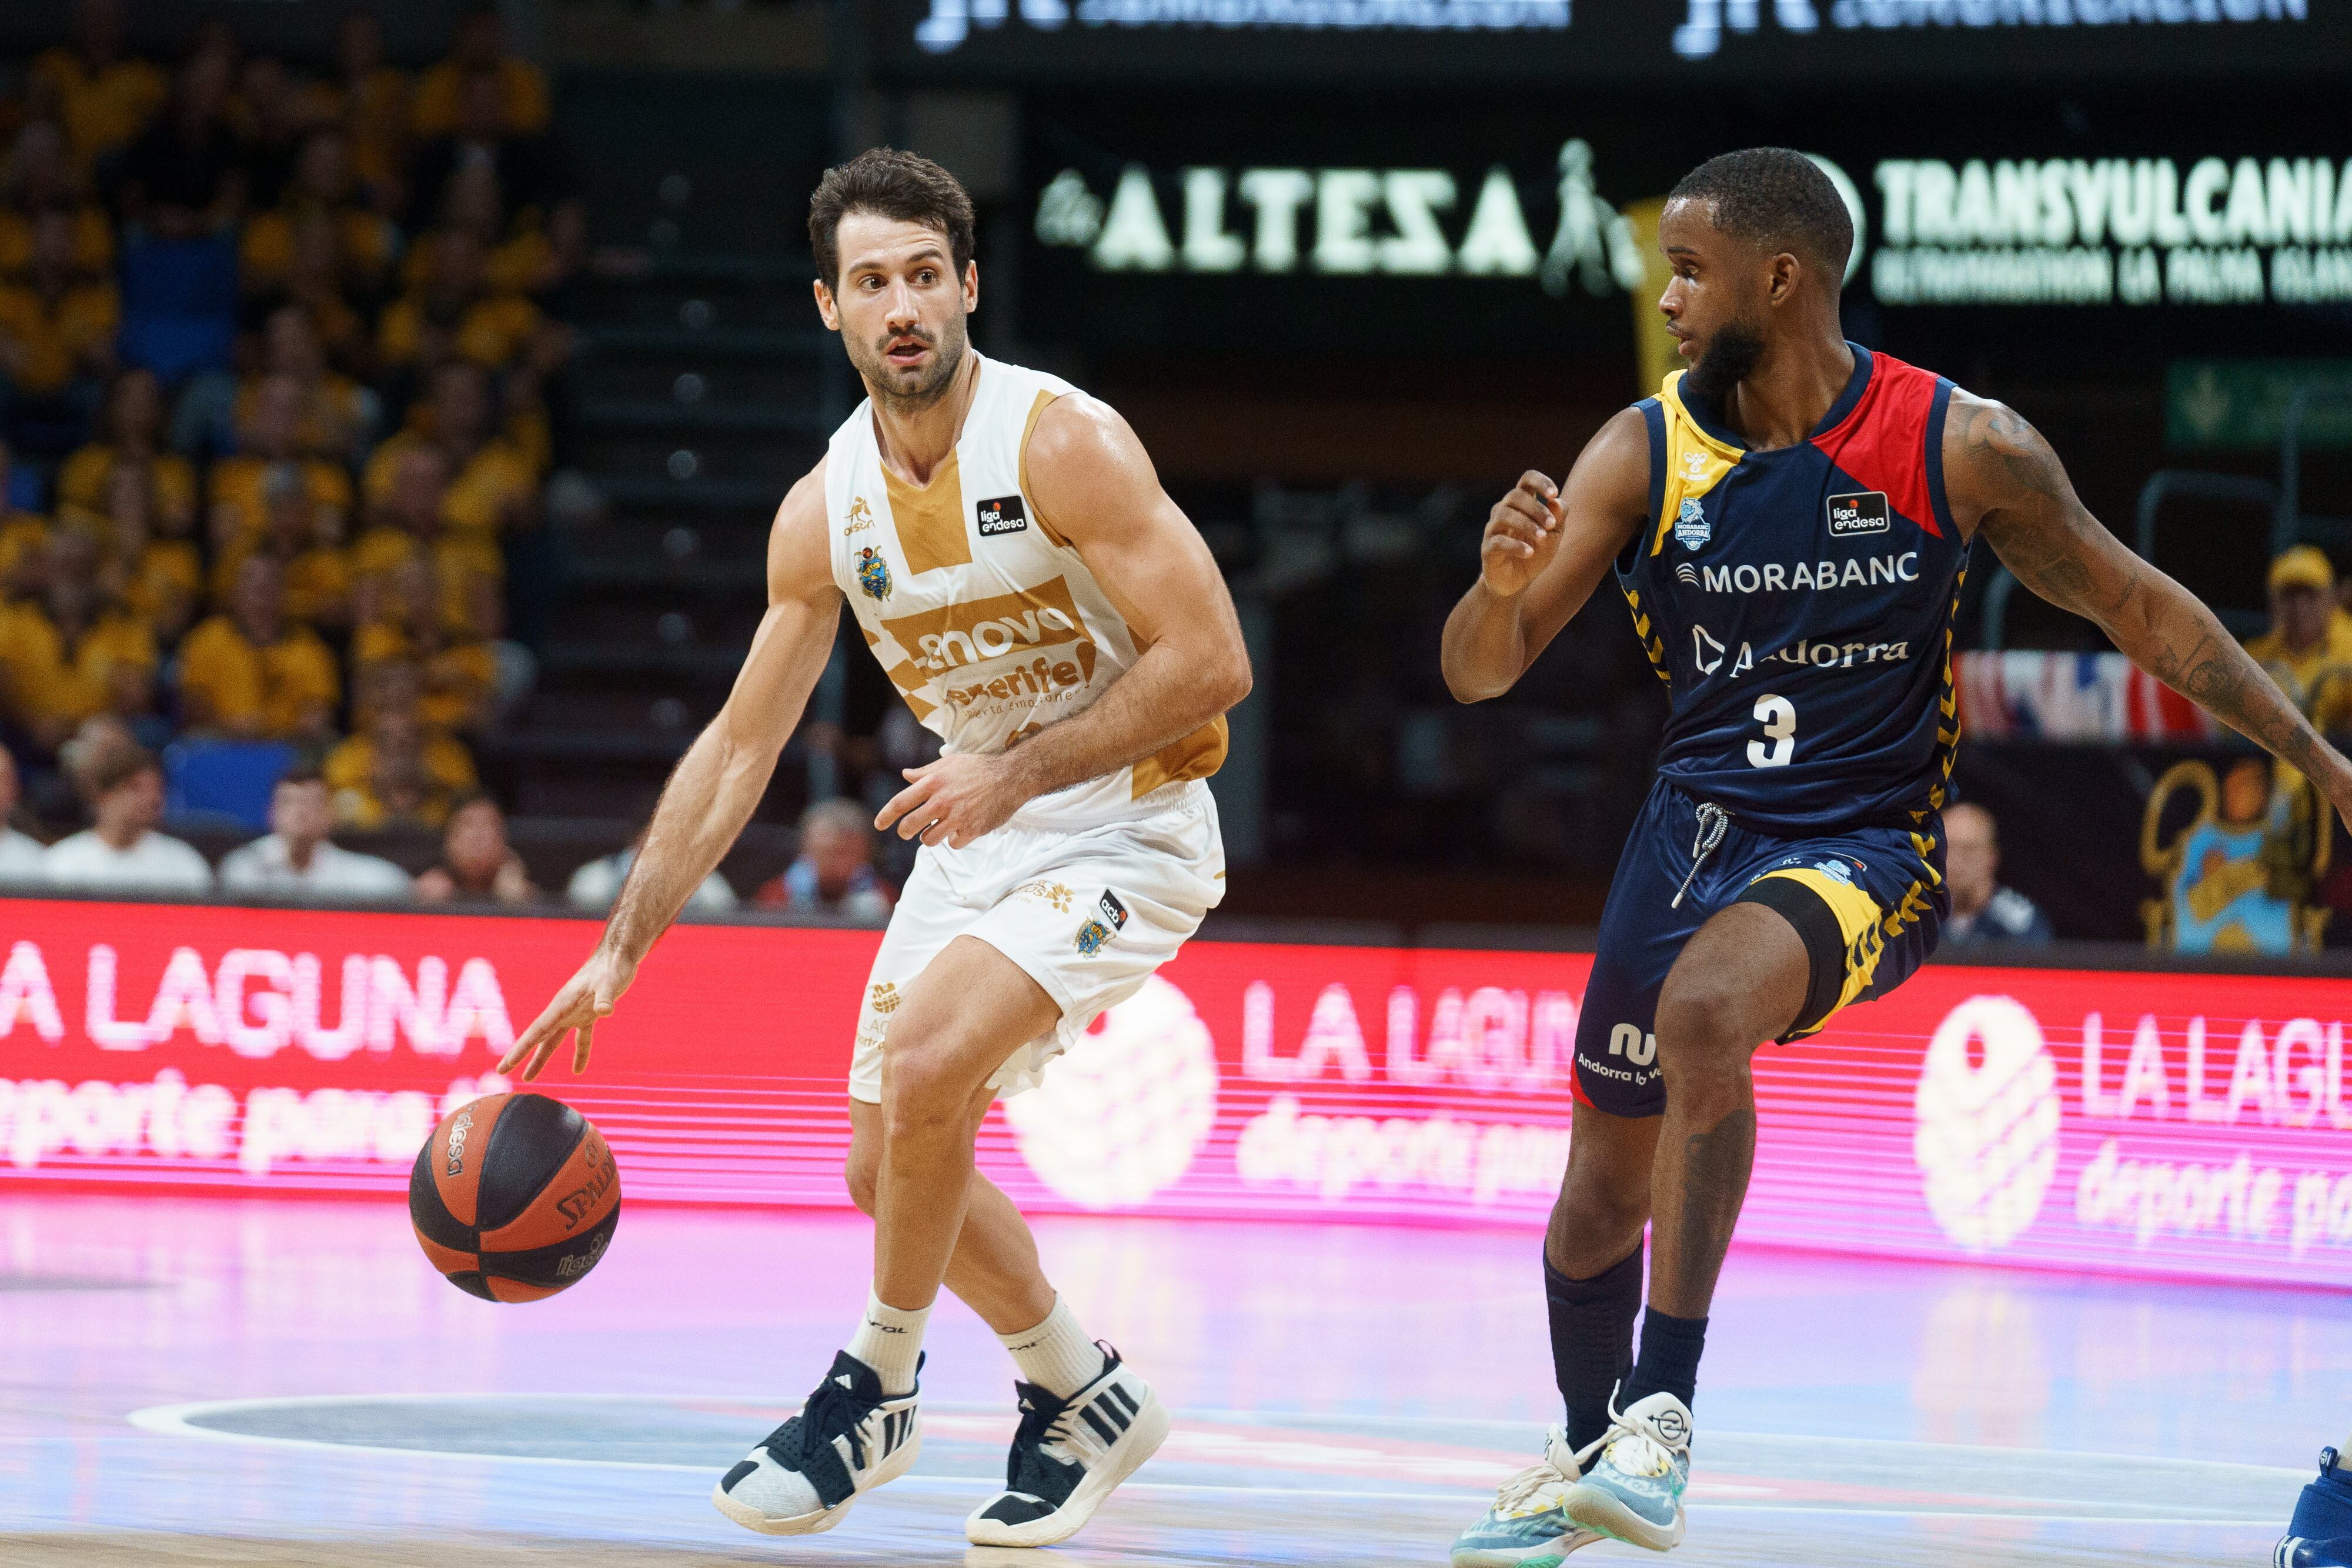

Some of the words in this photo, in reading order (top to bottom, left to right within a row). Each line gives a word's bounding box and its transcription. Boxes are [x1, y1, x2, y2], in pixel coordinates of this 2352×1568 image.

[981, 510, 1000, 522] liga
[982, 517, 1025, 533] endesa
[1833, 507, 1856, 520] liga
[1835, 517, 1885, 530] endesa
[1677, 530, 1709, 538] ANDORRA
[1704, 551, 1920, 593] MORABANC
[1729, 639, 1909, 678] Adorra
[1746, 693, 1796, 769] 3
[1101, 899, 1120, 924] acb
[86, 944, 514, 1058] LAGUNA
[1242, 980, 1372, 1080] LA
[1578, 1052, 1632, 1081] Andorra
[1636, 1071, 1647, 1085] la
[2082, 1012, 2170, 1120] LA
[0, 1067, 236, 1169] porte
